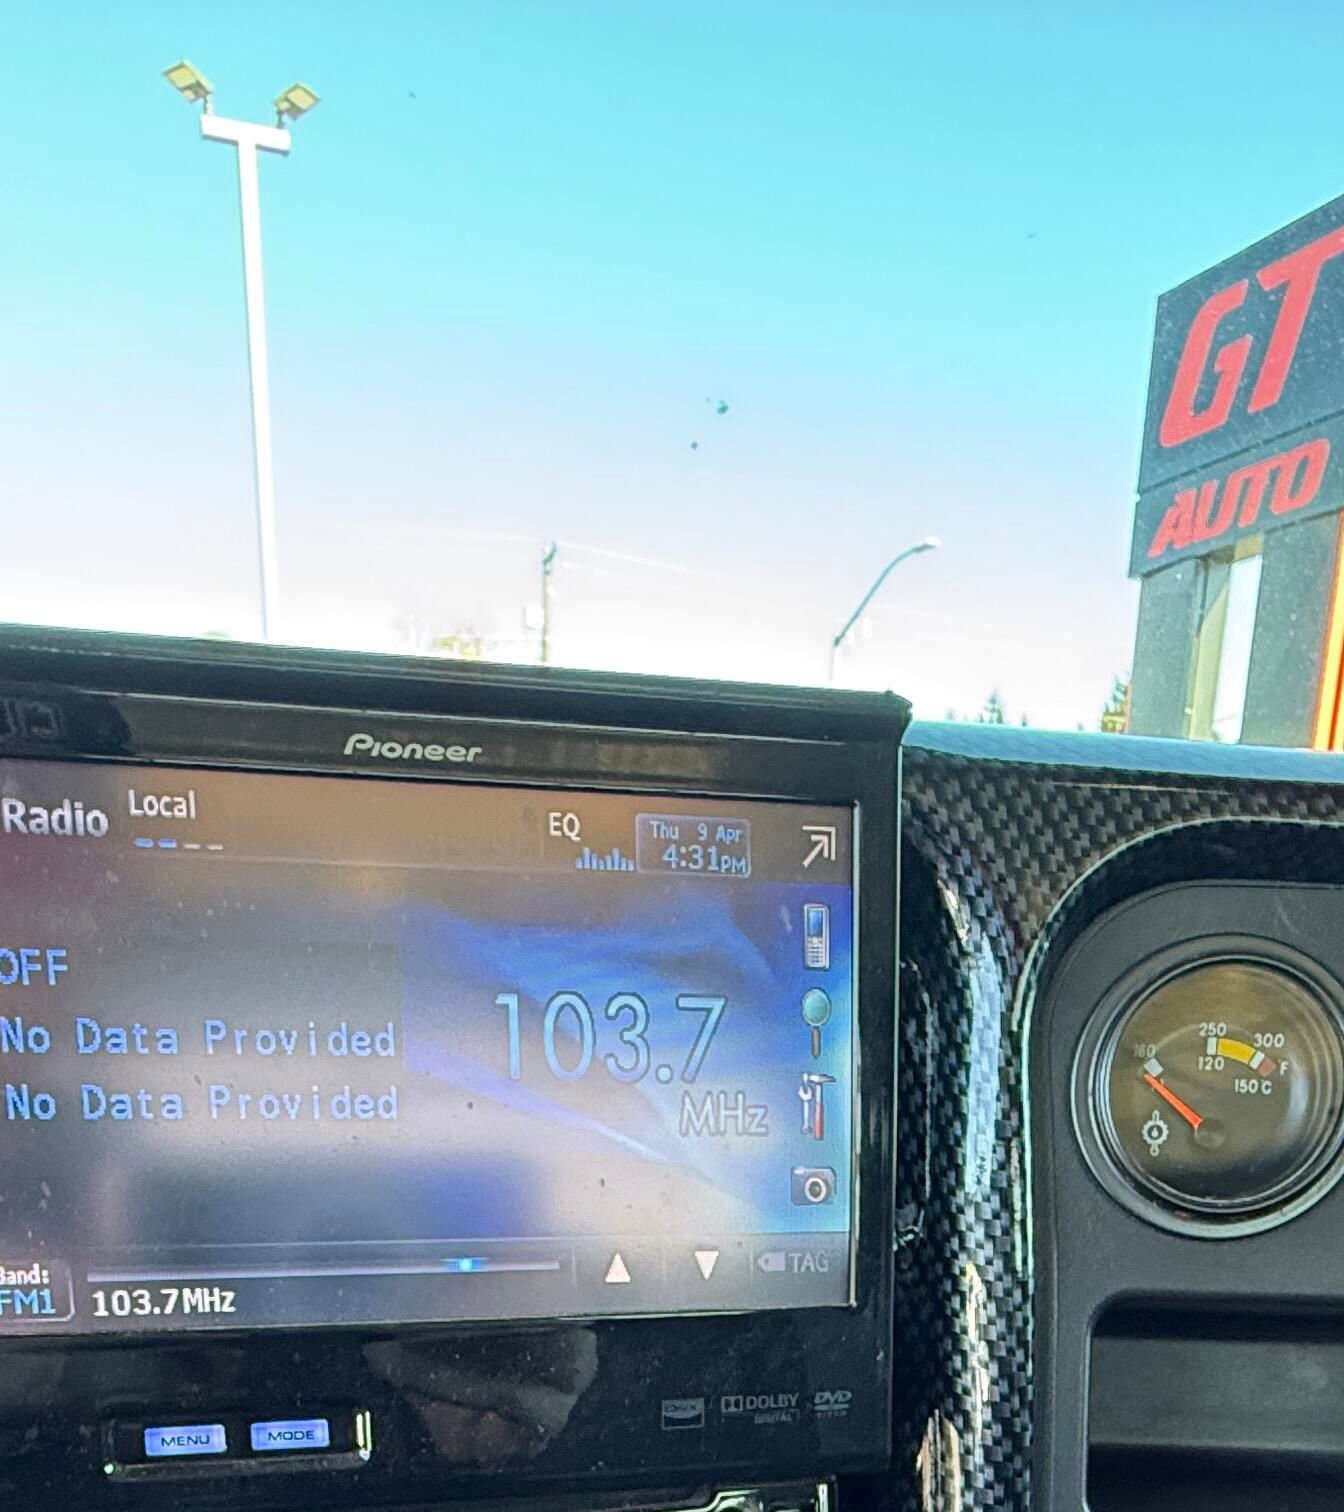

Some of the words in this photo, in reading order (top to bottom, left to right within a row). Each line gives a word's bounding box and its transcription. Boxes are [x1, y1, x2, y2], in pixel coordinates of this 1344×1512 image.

[1146, 439, 1331, 559] AUTO
[342, 732, 483, 764] Pioneer
[0, 797, 110, 839] Radio
[127, 788, 197, 820] Local
[548, 811, 582, 843] EQ
[649, 819, 680, 841] Thu
[697, 823, 709, 841] 9
[716, 824, 744, 845] Apr
[74, 1016, 180, 1056] Data
[203, 1019, 396, 1058] Provided
[493, 989, 730, 1085] 103.7
[1198, 1021, 1228, 1037] 250
[1253, 1032, 1286, 1049] 300
[1197, 1056, 1226, 1071] 120
[4, 1083, 57, 1121] No
[80, 1083, 184, 1121] Data
[208, 1084, 399, 1122] Provided
[677, 1089, 771, 1138] MHz
[788, 1250, 831, 1274] TAG
[745, 1391, 800, 1410] DOLBY
[159, 1432, 211, 1448] MENU
[266, 1428, 316, 1443] MODE
